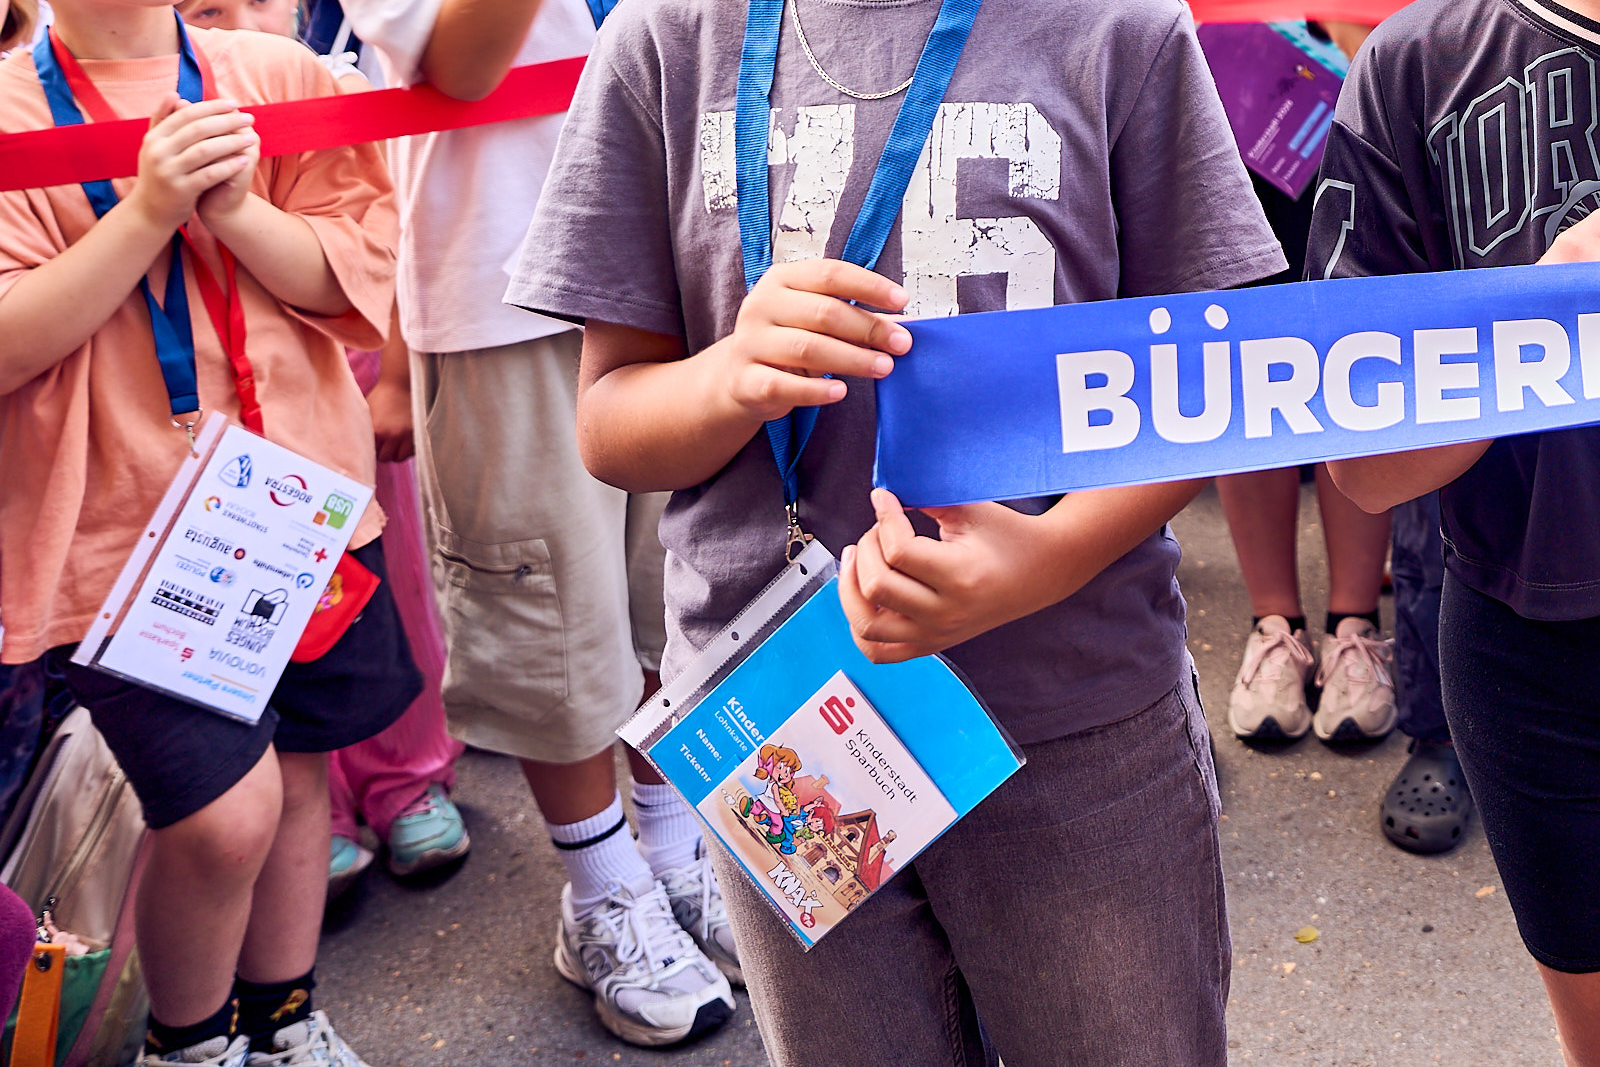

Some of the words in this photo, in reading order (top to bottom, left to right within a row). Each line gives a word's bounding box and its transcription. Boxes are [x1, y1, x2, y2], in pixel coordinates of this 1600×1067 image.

[265, 477, 312, 503] BOGESTRA
[325, 495, 352, 517] USB
[185, 529, 232, 555] augusta
[713, 710, 749, 753] Lohnkarte
[727, 696, 767, 746] Kinder
[678, 744, 712, 783] Ticketnr
[695, 729, 723, 762] Name:
[855, 728, 919, 804] Kinderstadt
[844, 738, 898, 800] Sparbuch
[767, 862, 824, 915] KNAX
